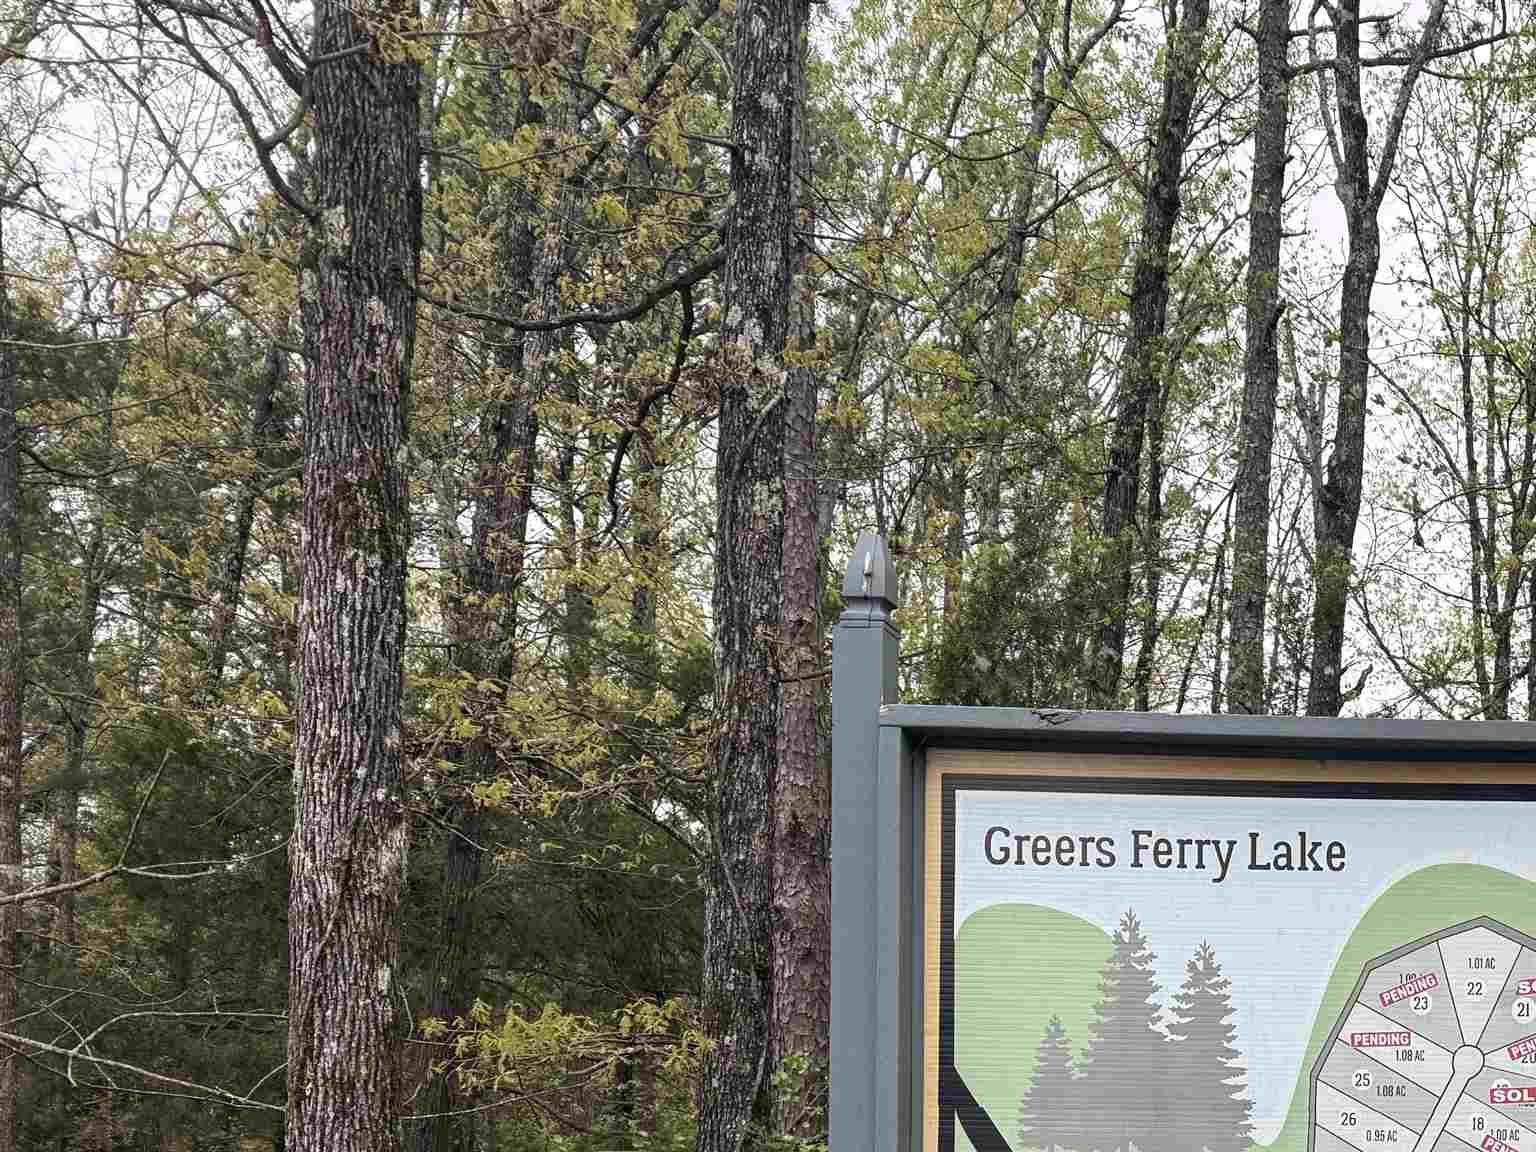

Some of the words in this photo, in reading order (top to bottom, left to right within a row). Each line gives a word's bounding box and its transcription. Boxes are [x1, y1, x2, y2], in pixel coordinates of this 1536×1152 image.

[985, 826, 1116, 867] Greers
[1131, 830, 1236, 883] Ferry
[1248, 831, 1346, 871] Lake
[1468, 957, 1483, 969] 1.01
[1485, 957, 1496, 969] AC
[1382, 975, 1437, 1005] PENDING
[1467, 982, 1483, 995] 22
[1414, 997, 1428, 1010] 23
[1517, 1002, 1530, 1017] 21
[1354, 1033, 1410, 1046] PENDING
[1355, 1073, 1370, 1087] 25
[1396, 1086, 1407, 1097] AC
[1341, 1113, 1356, 1126] 26
[1472, 1117, 1485, 1130] 18
[1387, 1131, 1398, 1142] AC
[1509, 1129, 1520, 1141] AC
